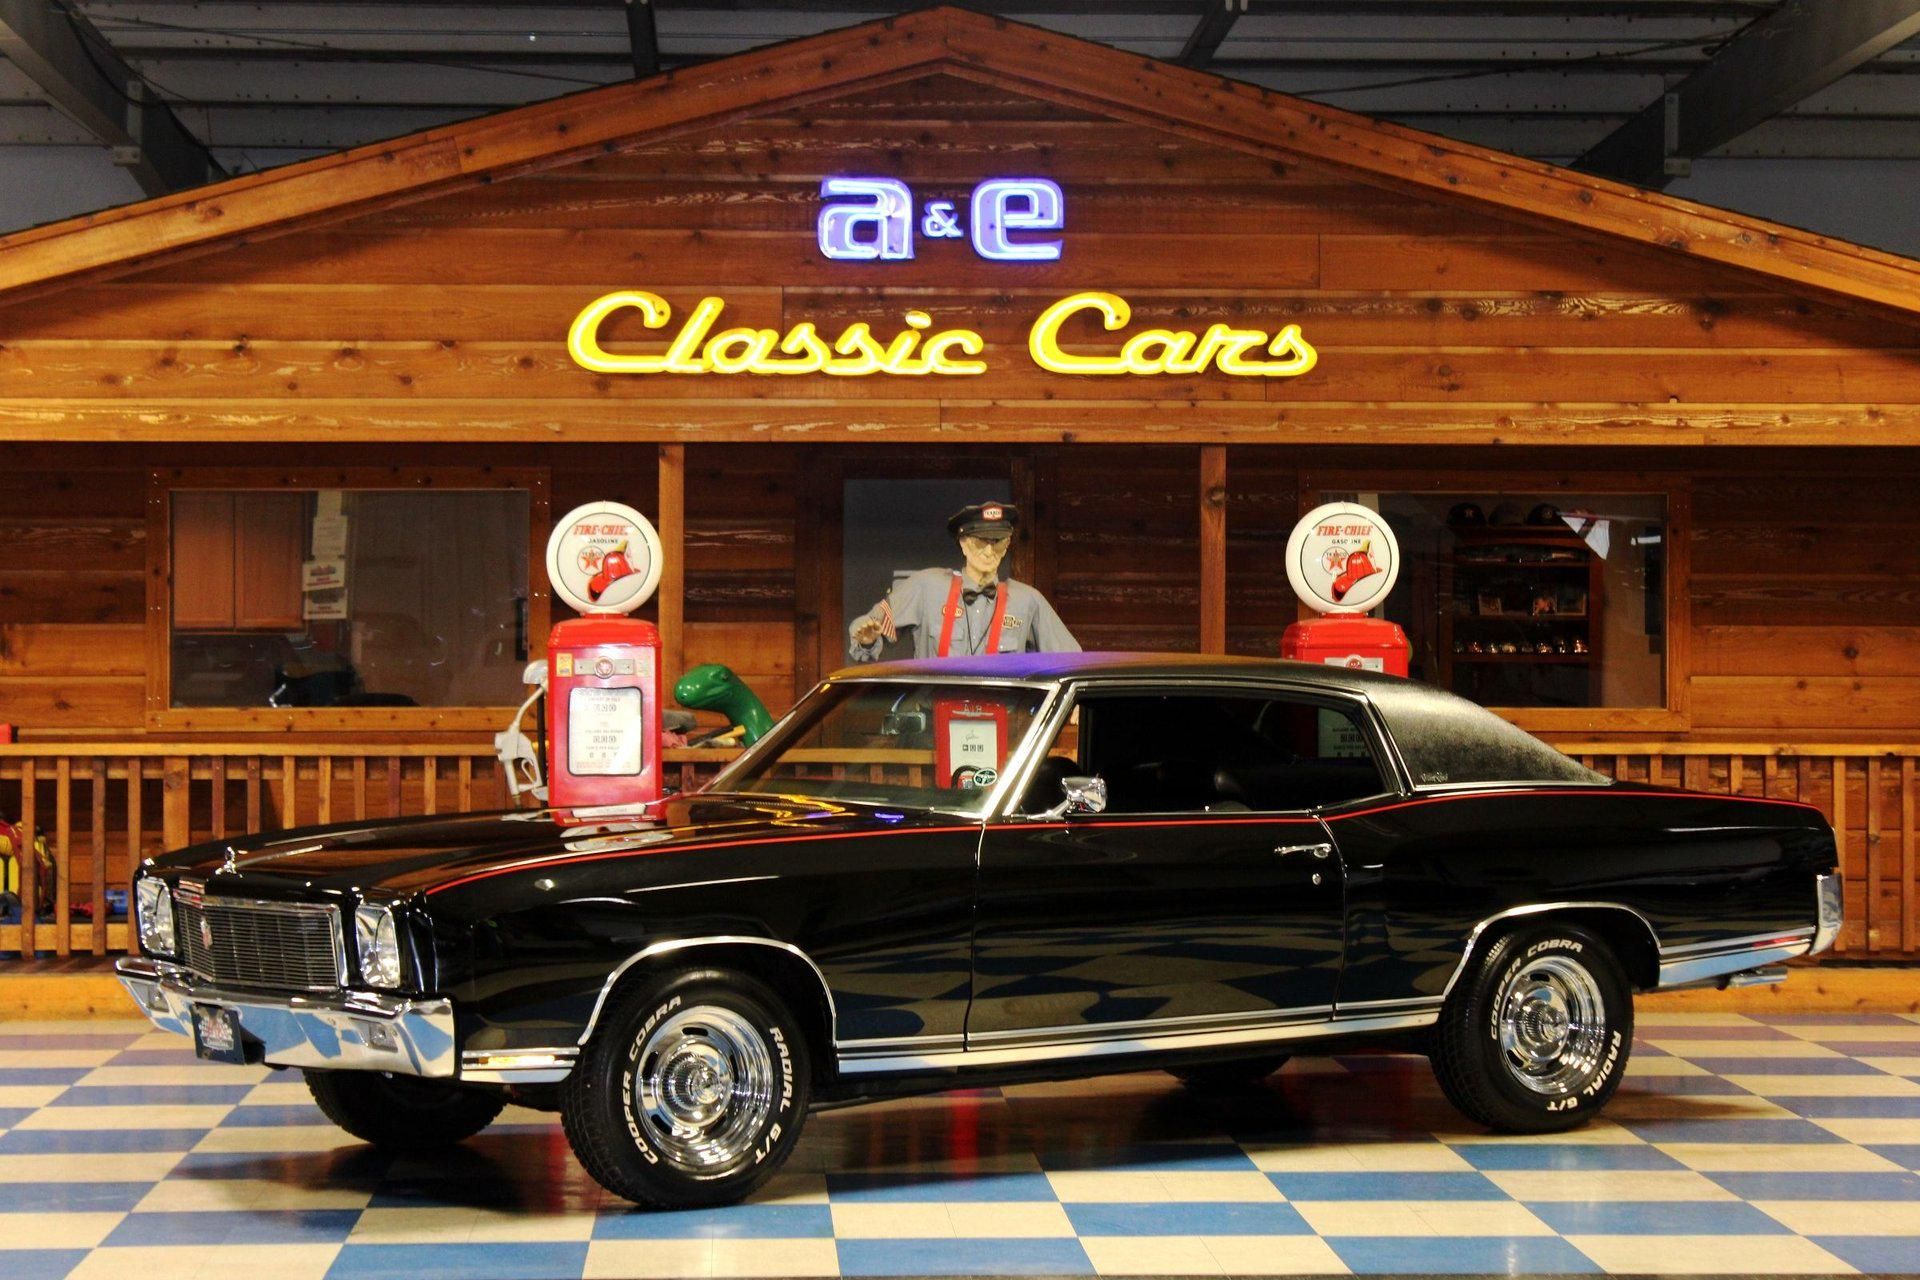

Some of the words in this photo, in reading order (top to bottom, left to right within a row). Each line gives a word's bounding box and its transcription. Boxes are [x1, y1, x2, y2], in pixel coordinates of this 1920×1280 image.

[818, 177, 914, 261] a
[921, 202, 964, 238] &
[970, 177, 1064, 261] e
[567, 290, 987, 376] Classic
[1029, 291, 1318, 377] Cars
[1317, 524, 1374, 537] FIRE-CHIEF
[1490, 957, 1522, 1040] COOPER
[1527, 938, 1583, 957] COBRA
[629, 995, 682, 1062] COBRA
[1583, 1030, 1621, 1096] RADIAL
[769, 1026, 793, 1113] RADIAL
[1546, 1096, 1578, 1111] G/T
[622, 1070, 659, 1165] COOPER
[754, 1122, 782, 1165] G/T
